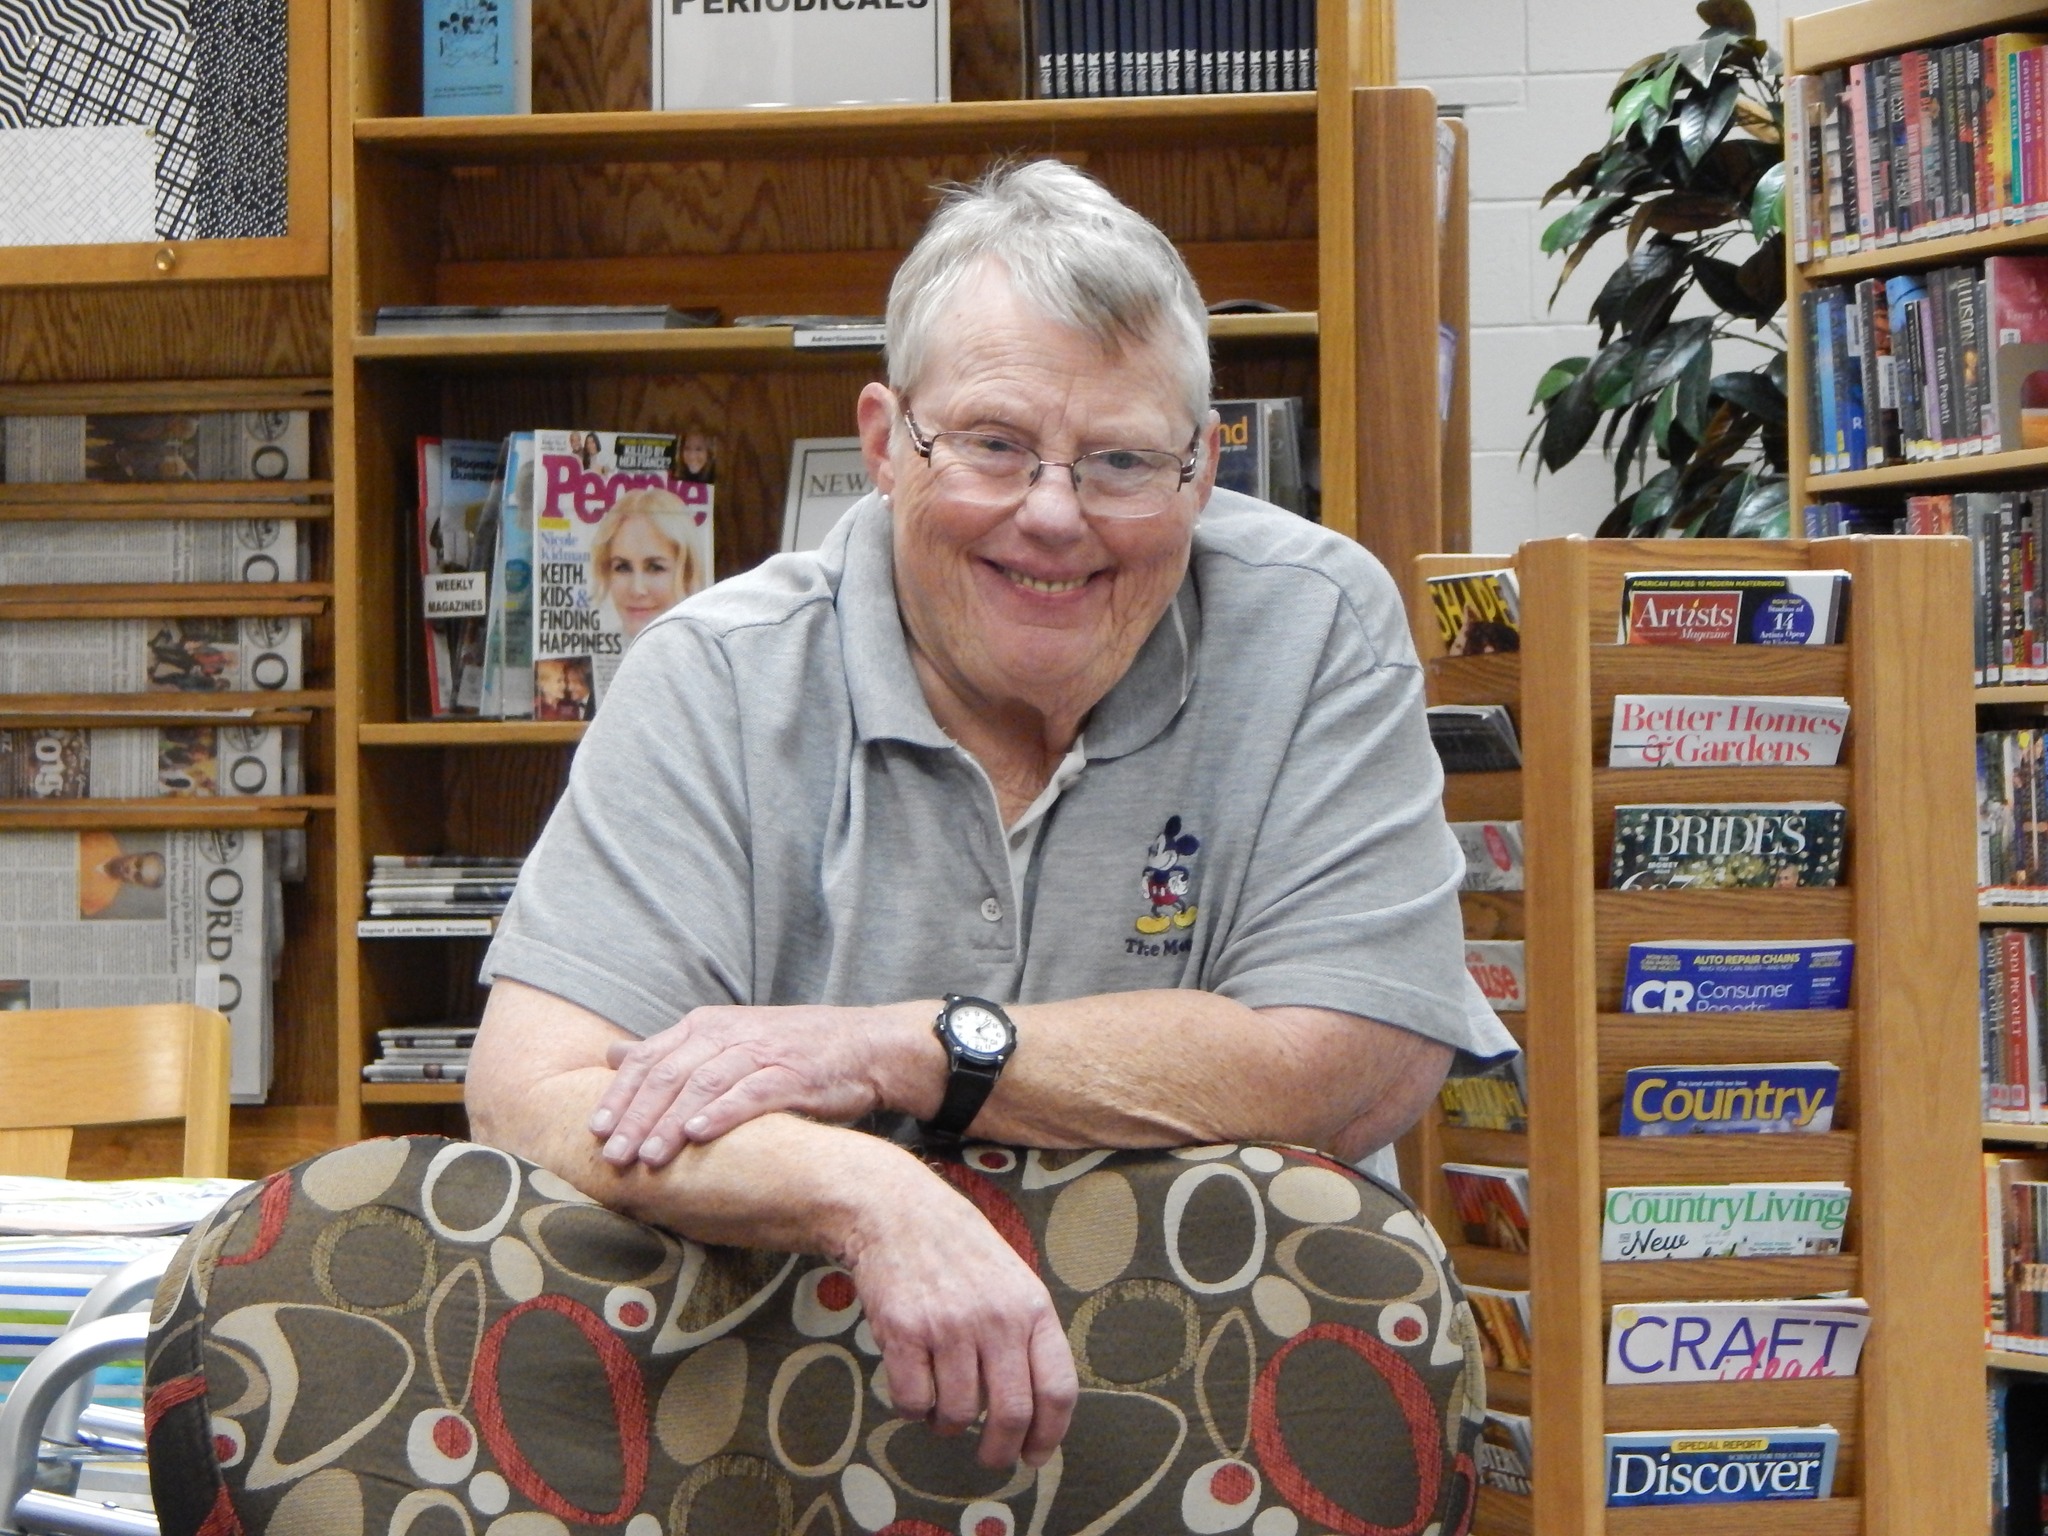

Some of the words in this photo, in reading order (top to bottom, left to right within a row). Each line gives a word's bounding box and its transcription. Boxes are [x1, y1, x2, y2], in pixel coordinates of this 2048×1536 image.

[1954, 51, 1966, 86] RIDLEY
[1891, 76, 1905, 123] WITNESSES
[2022, 60, 2031, 119] CATCHING
[2036, 111, 2041, 124] OF
[2024, 123, 2032, 143] AIR
[1957, 278, 1976, 345] ILLUSION
[1936, 346, 1948, 381] Frank
[1938, 384, 1951, 424] Peretti
[2000, 532, 2010, 594] NIGHT
[435, 579, 475, 592] WEEKLY
[541, 586, 574, 608] KIDS
[576, 589, 590, 609] &
[428, 598, 483, 613] MAGAZINES
[540, 609, 600, 631] FINDING
[1635, 598, 1733, 629] Artists
[1679, 628, 1731, 642] Magazine
[1760, 630, 1784, 638] Artists
[1785, 630, 1806, 640] Open
[1773, 612, 1794, 630] 14
[540, 632, 623, 655] HAPPINESS
[1621, 703, 1722, 732] Better
[1727, 704, 1843, 736] Homes
[1641, 734, 1674, 763] &
[1674, 734, 1812, 763] Gardens
[1651, 815, 1807, 856] BRIDES
[205, 868, 244, 962] ORD
[1125, 938, 1160, 957] The
[1694, 955, 1723, 965] AUTO
[1725, 954, 1762, 964] REPAIR
[1764, 953, 1800, 963] CHAINS
[1632, 979, 1694, 1013] CR
[1697, 980, 1792, 999] Consumer
[1632, 1078, 1826, 1126] Country
[1621, 1228, 1690, 1256] New
[1618, 1315, 1859, 1374] CRAFT
[1678, 1441, 1721, 1451] SPECIAL
[1722, 1439, 1763, 1450] REPORT
[1612, 1453, 1820, 1498] Discover
